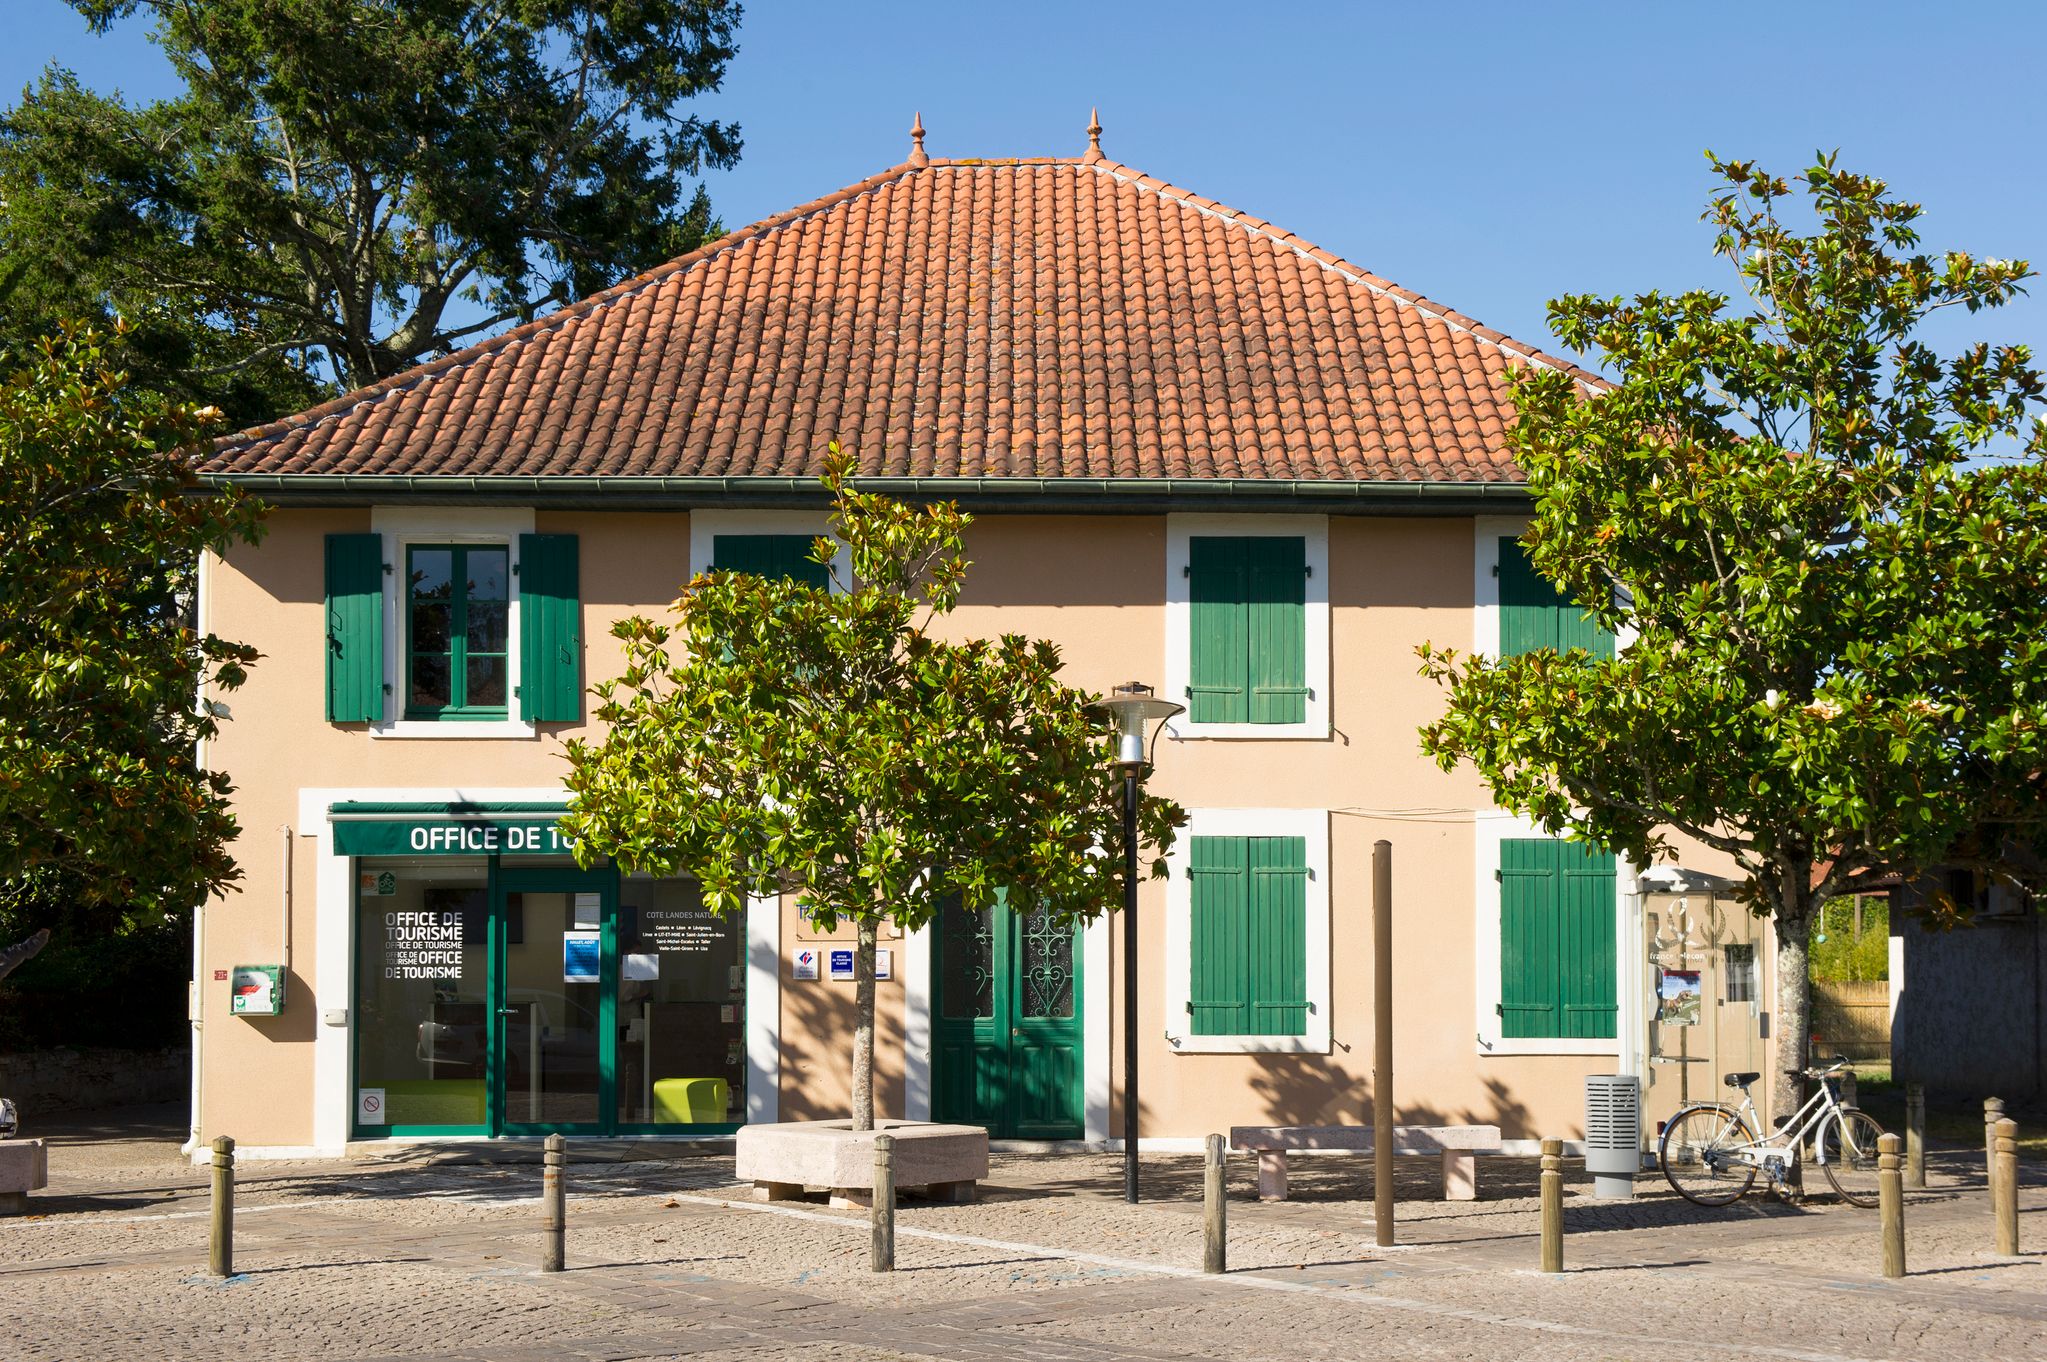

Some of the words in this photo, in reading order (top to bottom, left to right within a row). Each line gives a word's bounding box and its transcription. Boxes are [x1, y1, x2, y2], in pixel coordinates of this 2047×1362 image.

[410, 827, 498, 850] OFFICE
[507, 827, 541, 849] DE
[385, 912, 438, 926] OFFICE
[443, 912, 463, 926] DE
[646, 911, 664, 919] COTE
[665, 911, 693, 919] LANDES
[385, 927, 463, 941] TOURISME
[385, 941, 411, 949] OFFICE
[412, 941, 423, 949] DE
[424, 941, 463, 949] TOURISME
[418, 951, 463, 964] OFFICE
[385, 967, 401, 979] DE
[402, 967, 462, 979] TOURISME
